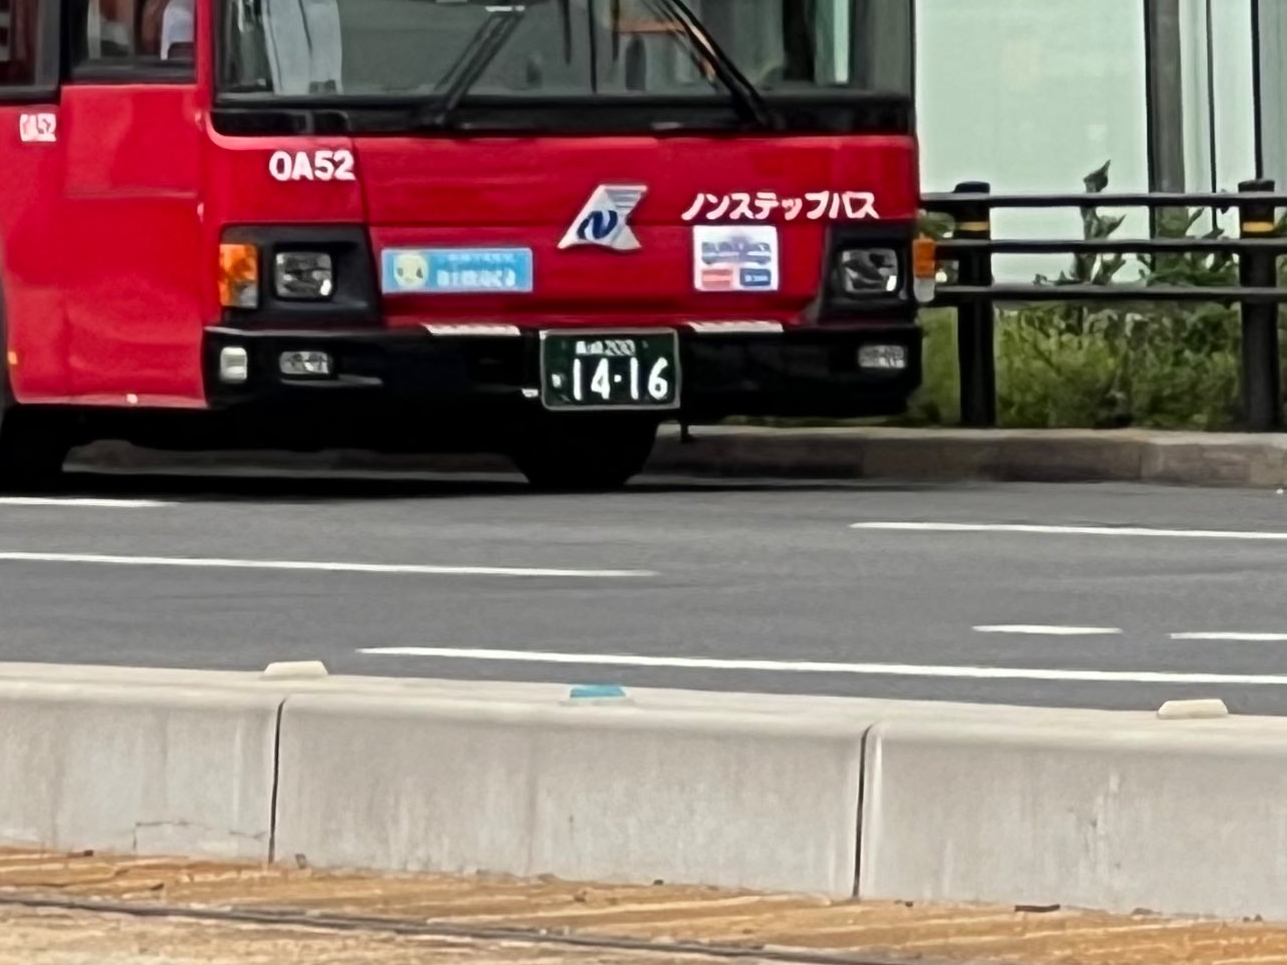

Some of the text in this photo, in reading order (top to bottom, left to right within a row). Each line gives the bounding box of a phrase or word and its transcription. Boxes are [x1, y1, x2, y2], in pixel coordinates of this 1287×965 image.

[680, 190, 881, 222] ノンステップバス
